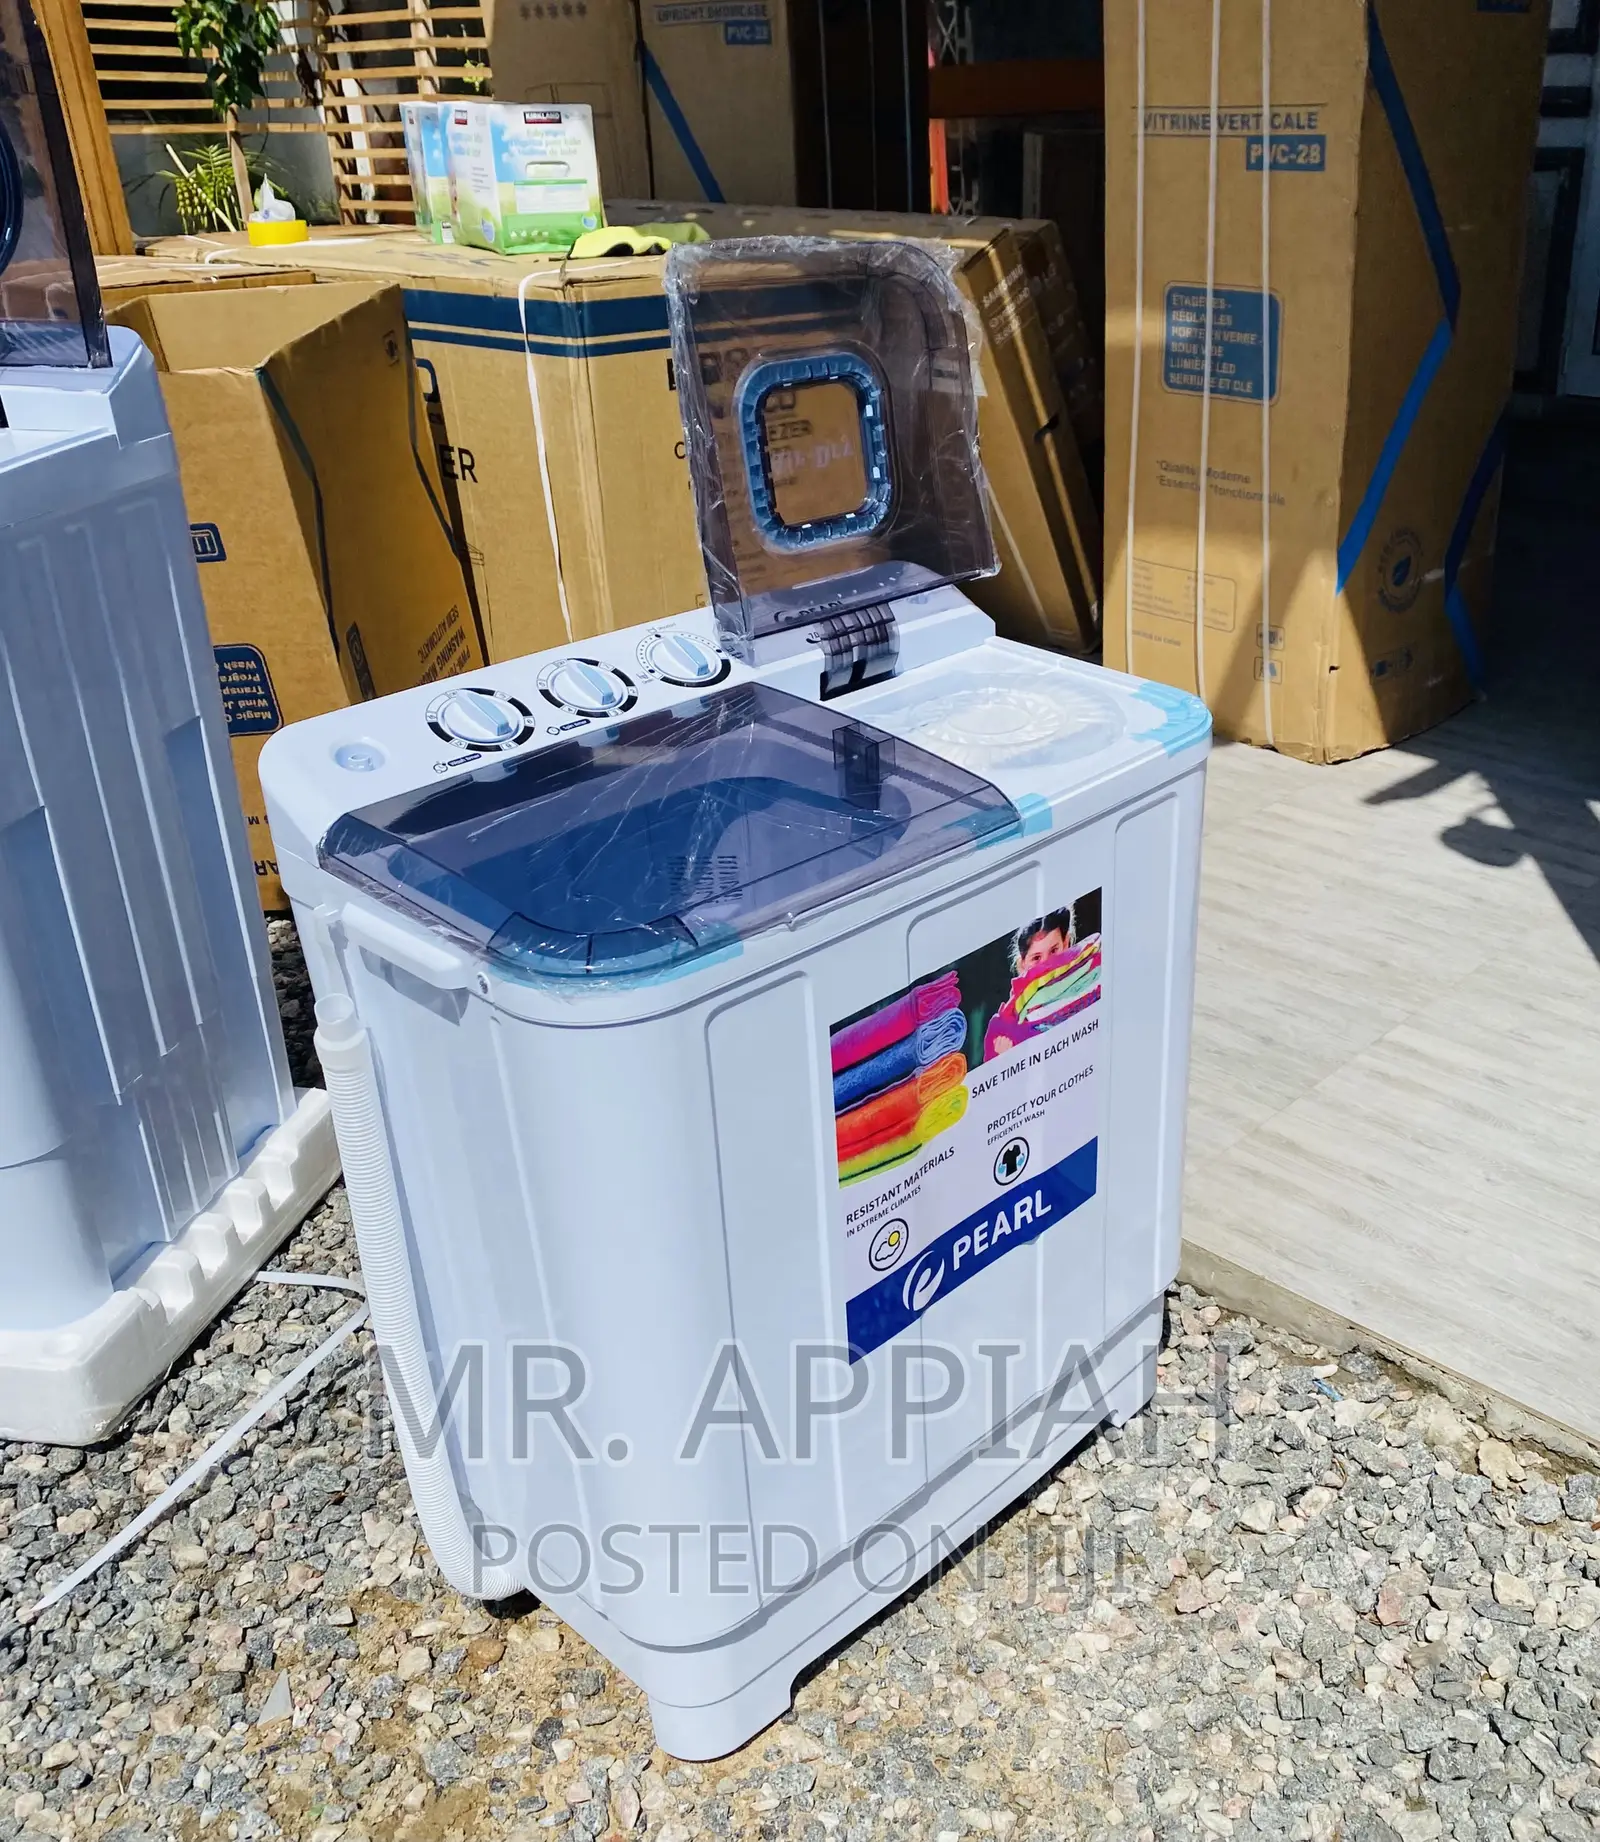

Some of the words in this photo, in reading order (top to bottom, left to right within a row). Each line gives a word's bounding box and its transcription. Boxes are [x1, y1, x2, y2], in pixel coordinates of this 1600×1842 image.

[1143, 113, 1211, 131] VITRINE
[1216, 111, 1319, 131] VERTCALE
[1201, 345, 1224, 357] VDE
[1170, 372, 1216, 389] SERRUE
[440, 443, 479, 483] ER
[223, 660, 257, 671] Wash
[220, 672, 261, 682] Progra
[223, 685, 265, 695] Transp
[238, 698, 269, 708] Wind
[236, 710, 272, 720] Magic
[972, 1075, 998, 1099] SAVE
[1000, 1059, 1026, 1082] TIME
[1029, 1052, 1042, 1067] IN
[1044, 1036, 1069, 1060] EACH
[1071, 1019, 1099, 1044] WASH
[987, 1102, 1028, 1134] PROTECT
[1029, 1088, 1057, 1109] YOUR
[1058, 1064, 1094, 1094] CLOTHES
[987, 1118, 1024, 1146] EFFICIENTLY
[1024, 1109, 1045, 1123] WASH
[846, 1183, 902, 1225] RESISTANT
[904, 1146, 955, 1190] MATERIALS
[846, 1228, 855, 1238] IN
[856, 1206, 890, 1233] EXTREME
[890, 1184, 922, 1211] CLIMATES
[953, 1189, 1052, 1271] PEARL
